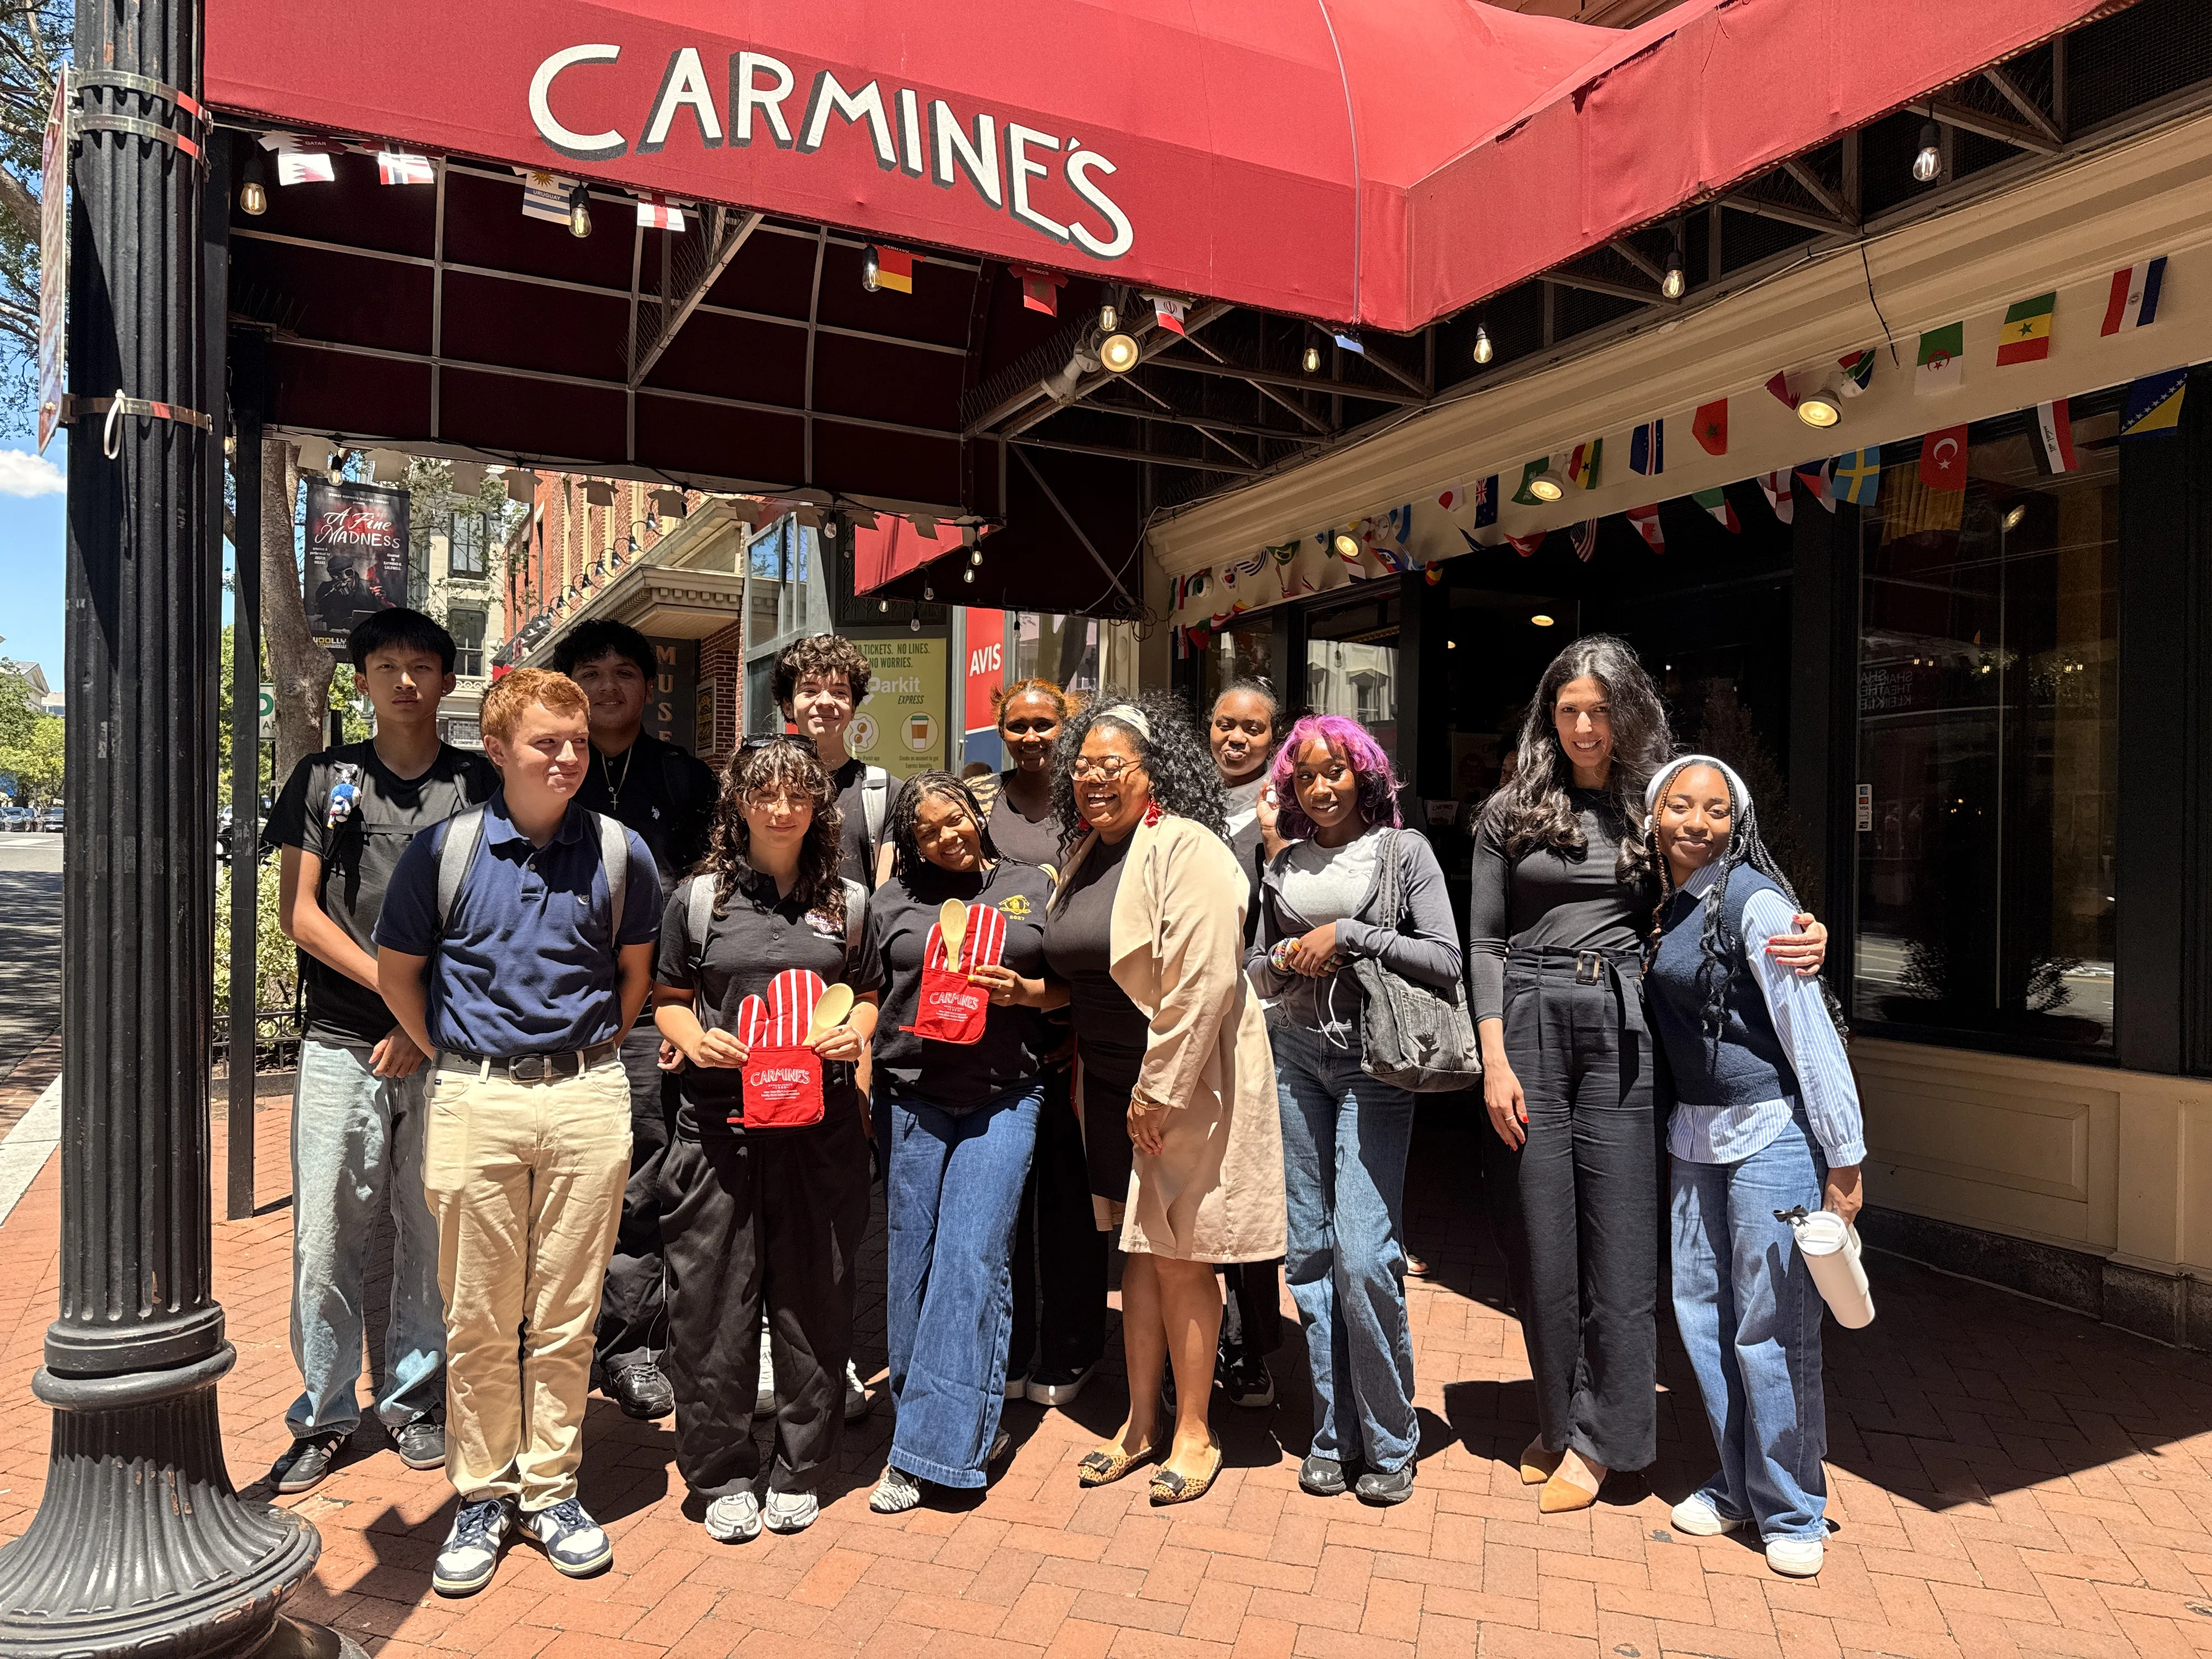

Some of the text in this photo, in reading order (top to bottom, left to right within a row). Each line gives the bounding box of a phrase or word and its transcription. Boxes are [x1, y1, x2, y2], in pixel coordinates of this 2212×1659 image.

[528, 43, 1134, 260] CARMINE'S
[533, 189, 561, 201] URUGUAY
[1026, 267, 1049, 275] MOROCCO
[324, 507, 392, 531] A Fine
[314, 524, 401, 549] MADNESS
[864, 644, 893, 654] TICKETS.
[897, 644, 907, 654] NO
[909, 643, 930, 654] LINES.
[869, 657, 913, 669] NO WORRIES.
[969, 643, 1001, 677] AVIS
[898, 695, 924, 704] EXPRESS
[929, 991, 979, 1011] CARMINE'S
[751, 1068, 811, 1087] CARMINE'S
